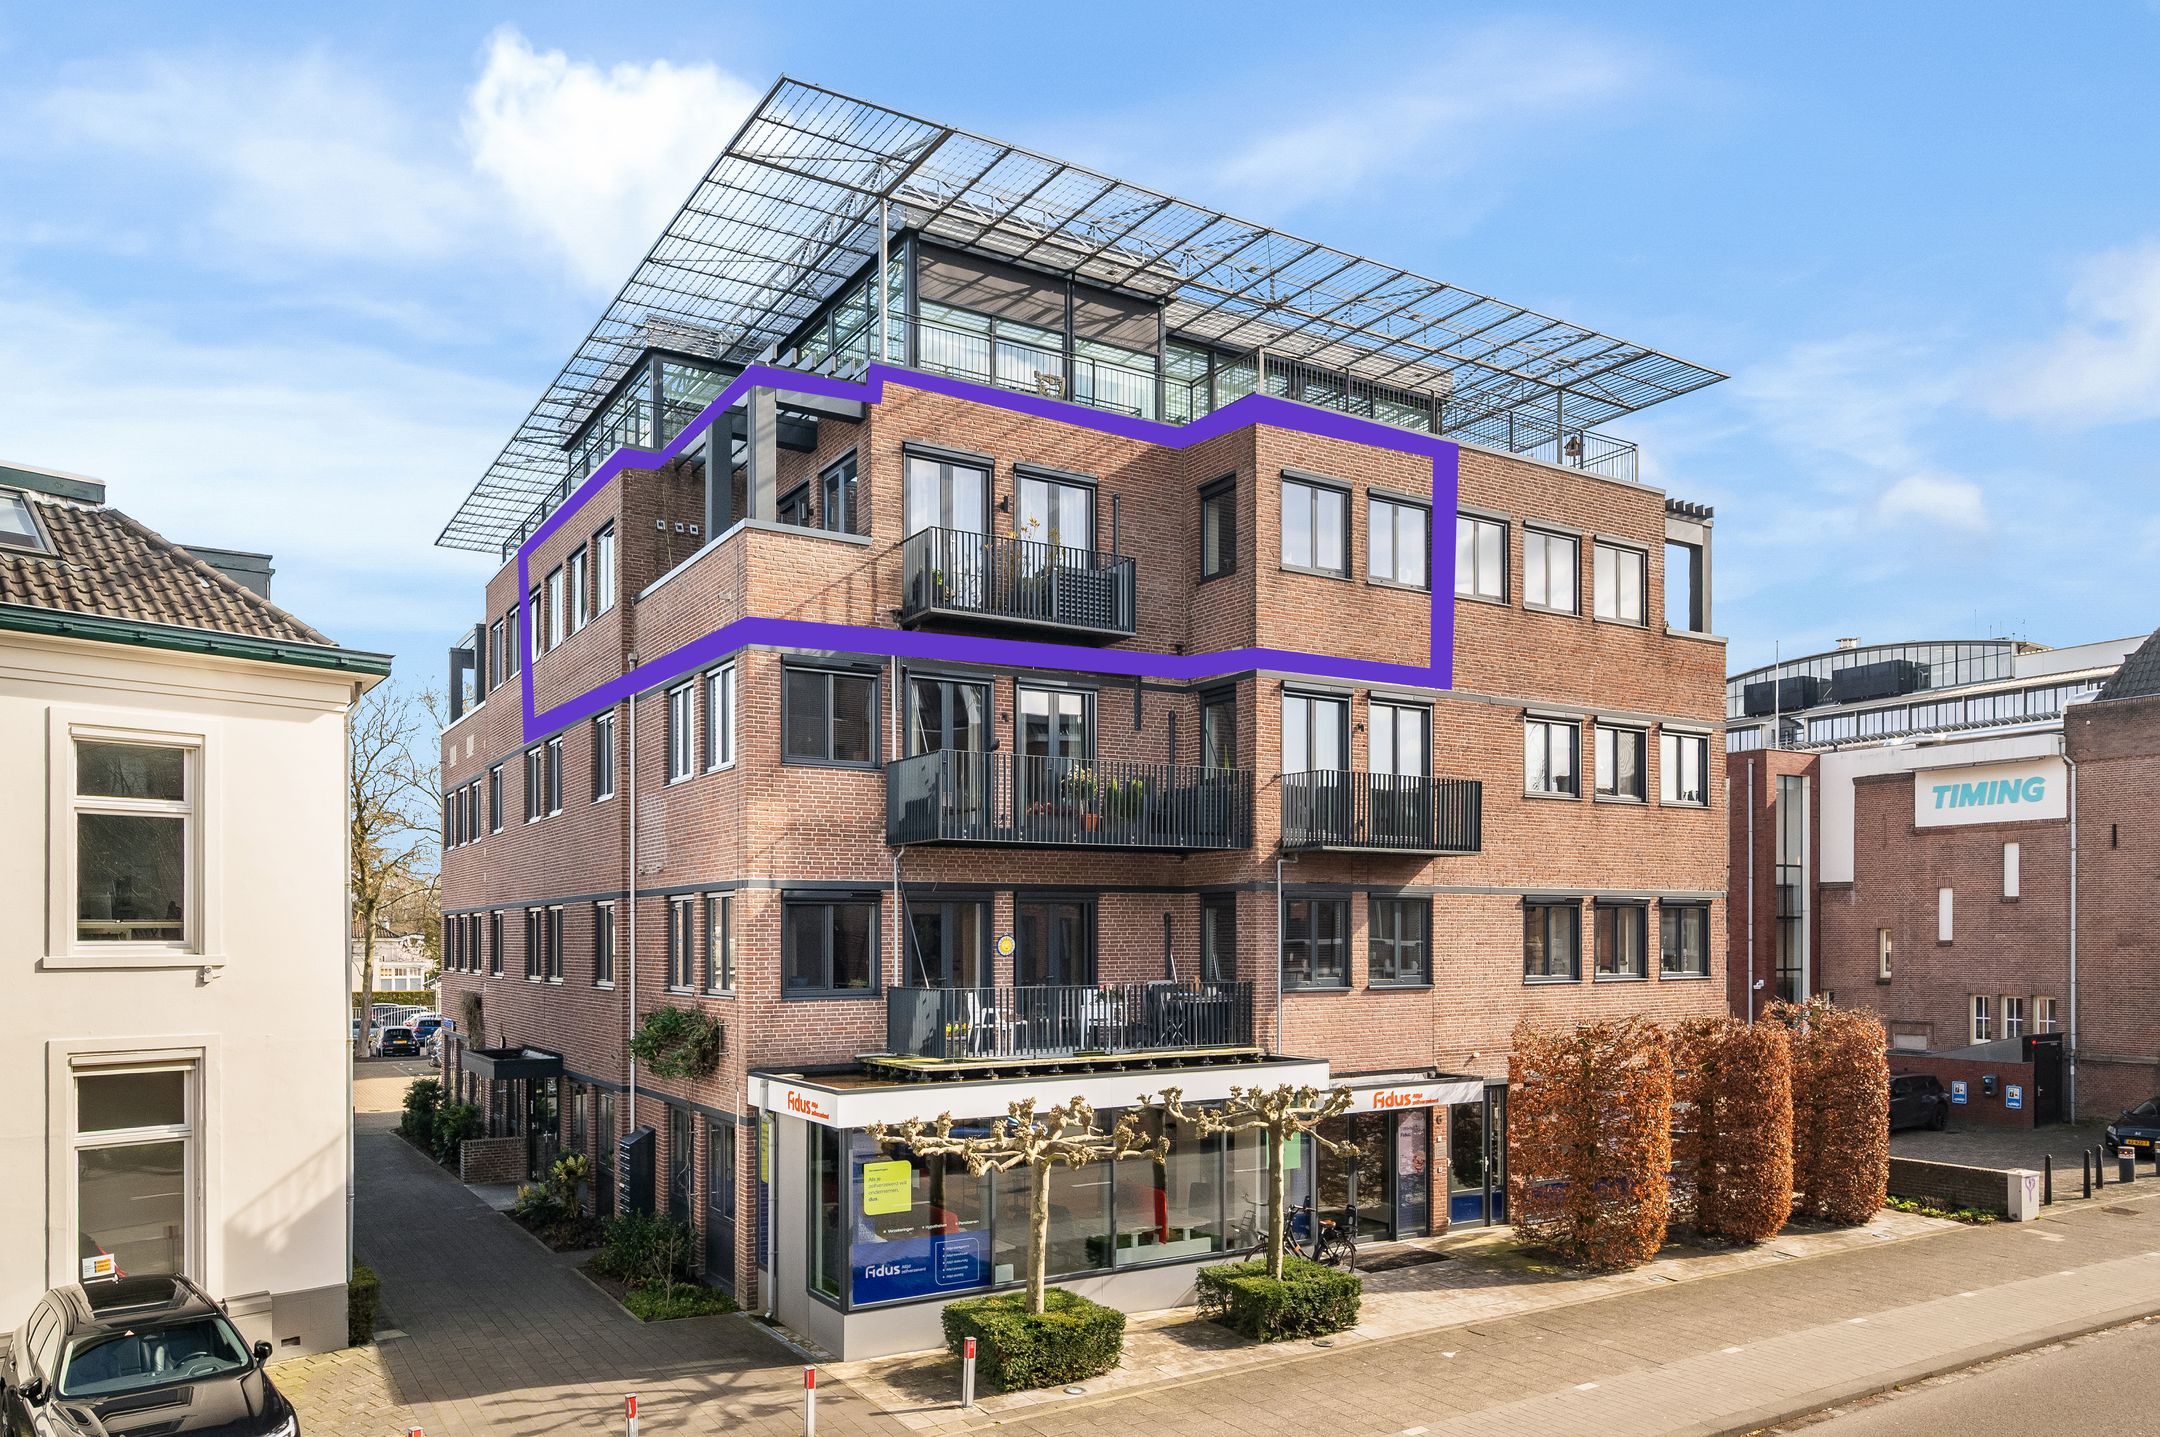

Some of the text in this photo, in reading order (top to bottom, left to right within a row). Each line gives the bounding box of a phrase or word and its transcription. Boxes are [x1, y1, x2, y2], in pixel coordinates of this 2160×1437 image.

[1932, 776, 2047, 809] TIMING
[787, 1091, 811, 1115] Fidus
[1373, 1090, 1412, 1109] Fidus
[865, 1264, 900, 1279] Fidus
